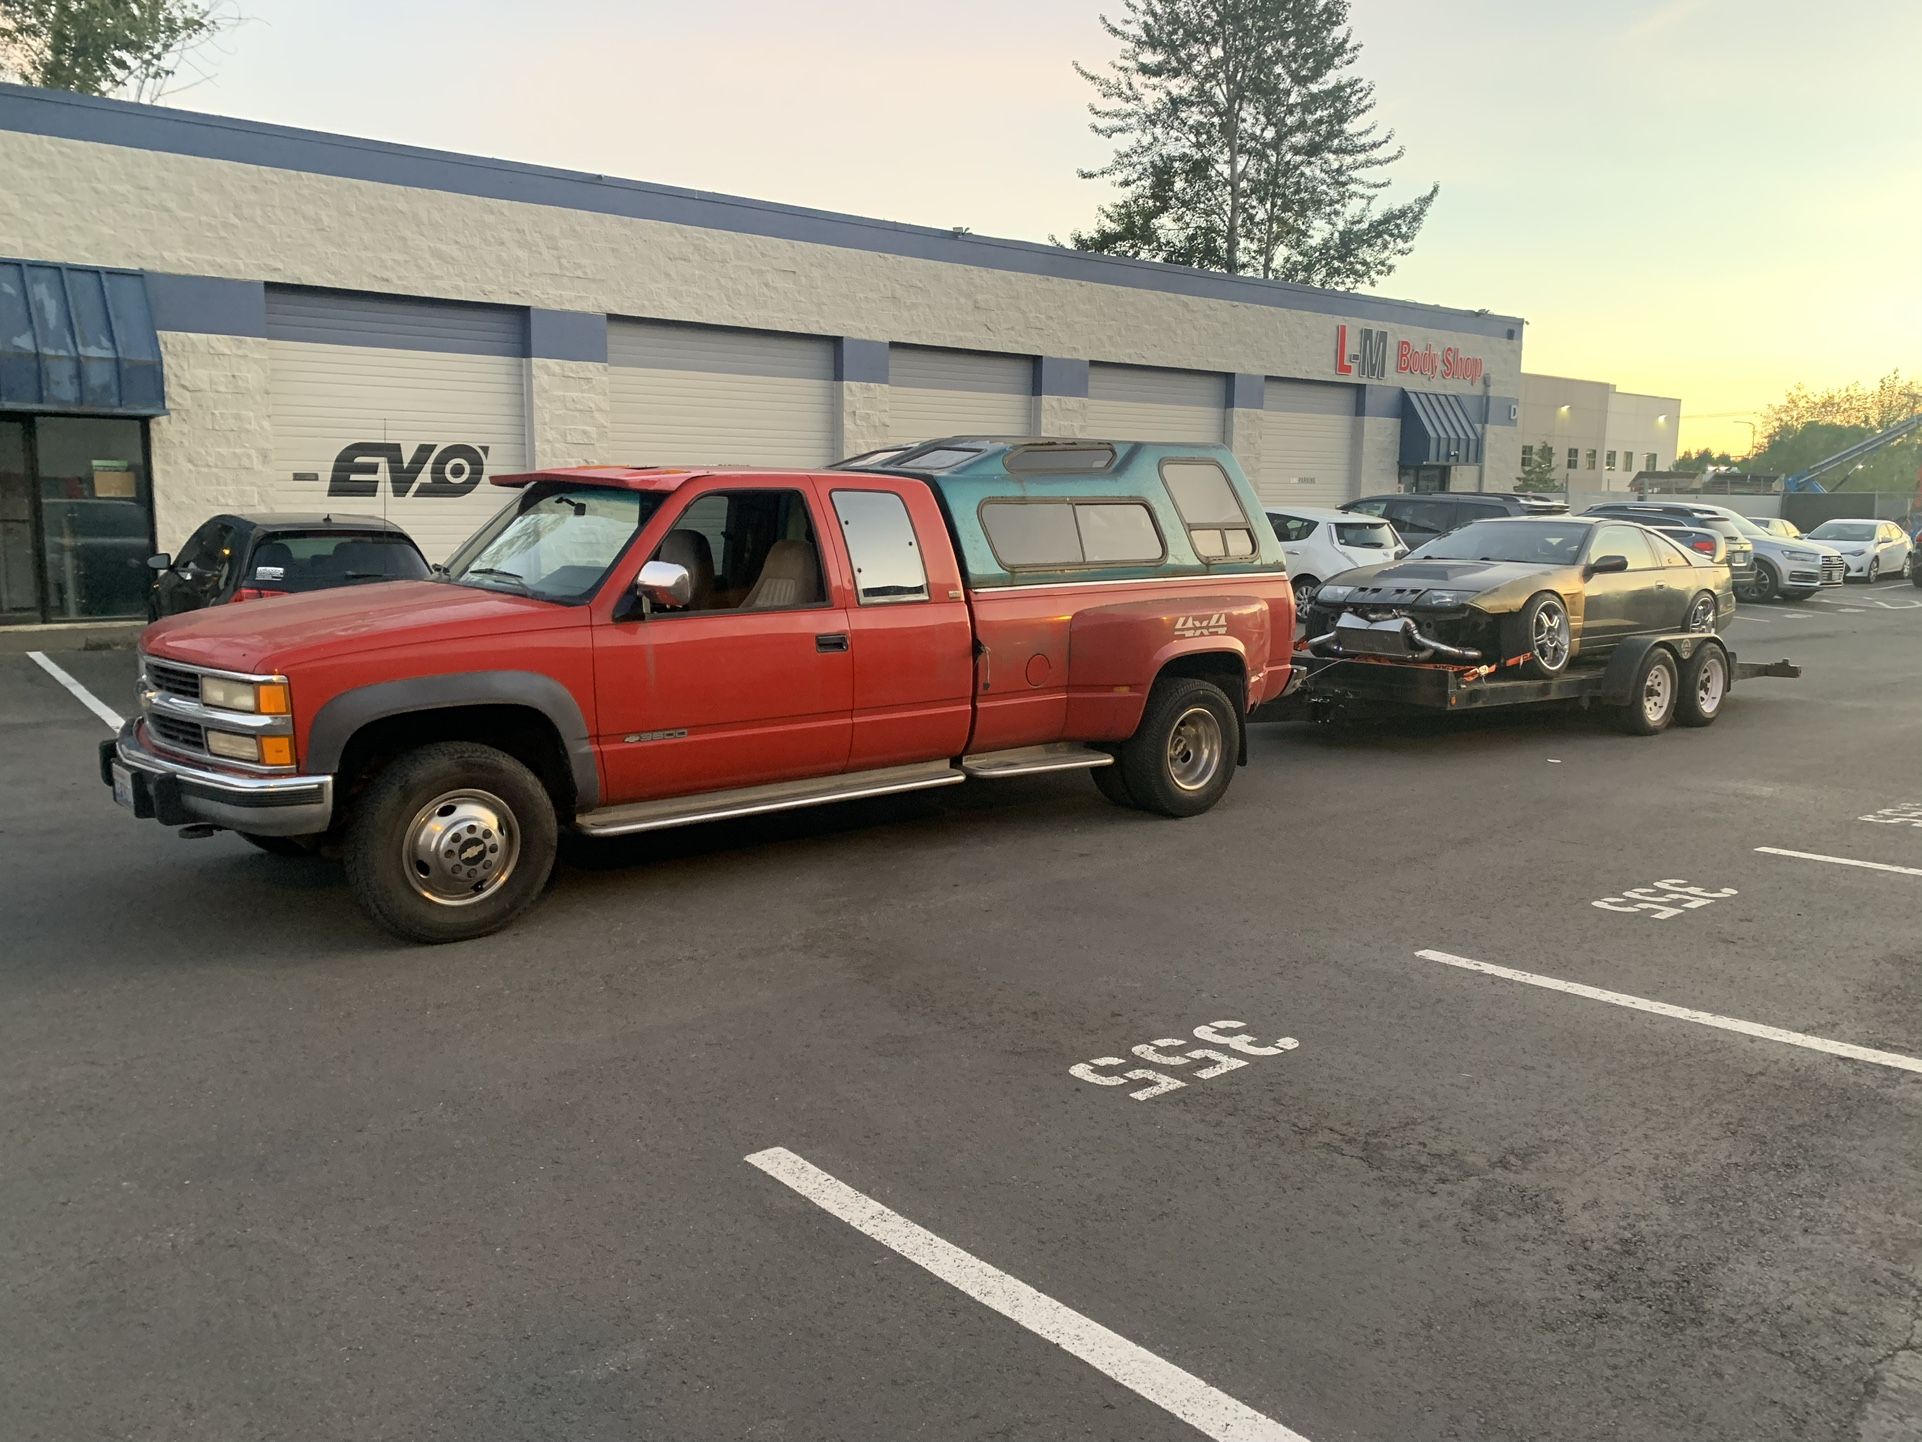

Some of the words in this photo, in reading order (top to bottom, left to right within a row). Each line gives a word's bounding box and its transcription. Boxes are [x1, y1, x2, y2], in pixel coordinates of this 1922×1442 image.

[1336, 323, 1388, 379] L-M
[1397, 339, 1439, 380] Body
[1441, 346, 1484, 385] Shop
[327, 441, 490, 498] EVO
[1174, 613, 1228, 638] 4x4
[1591, 878, 1739, 920] 355
[1068, 1020, 1300, 1101] 355
